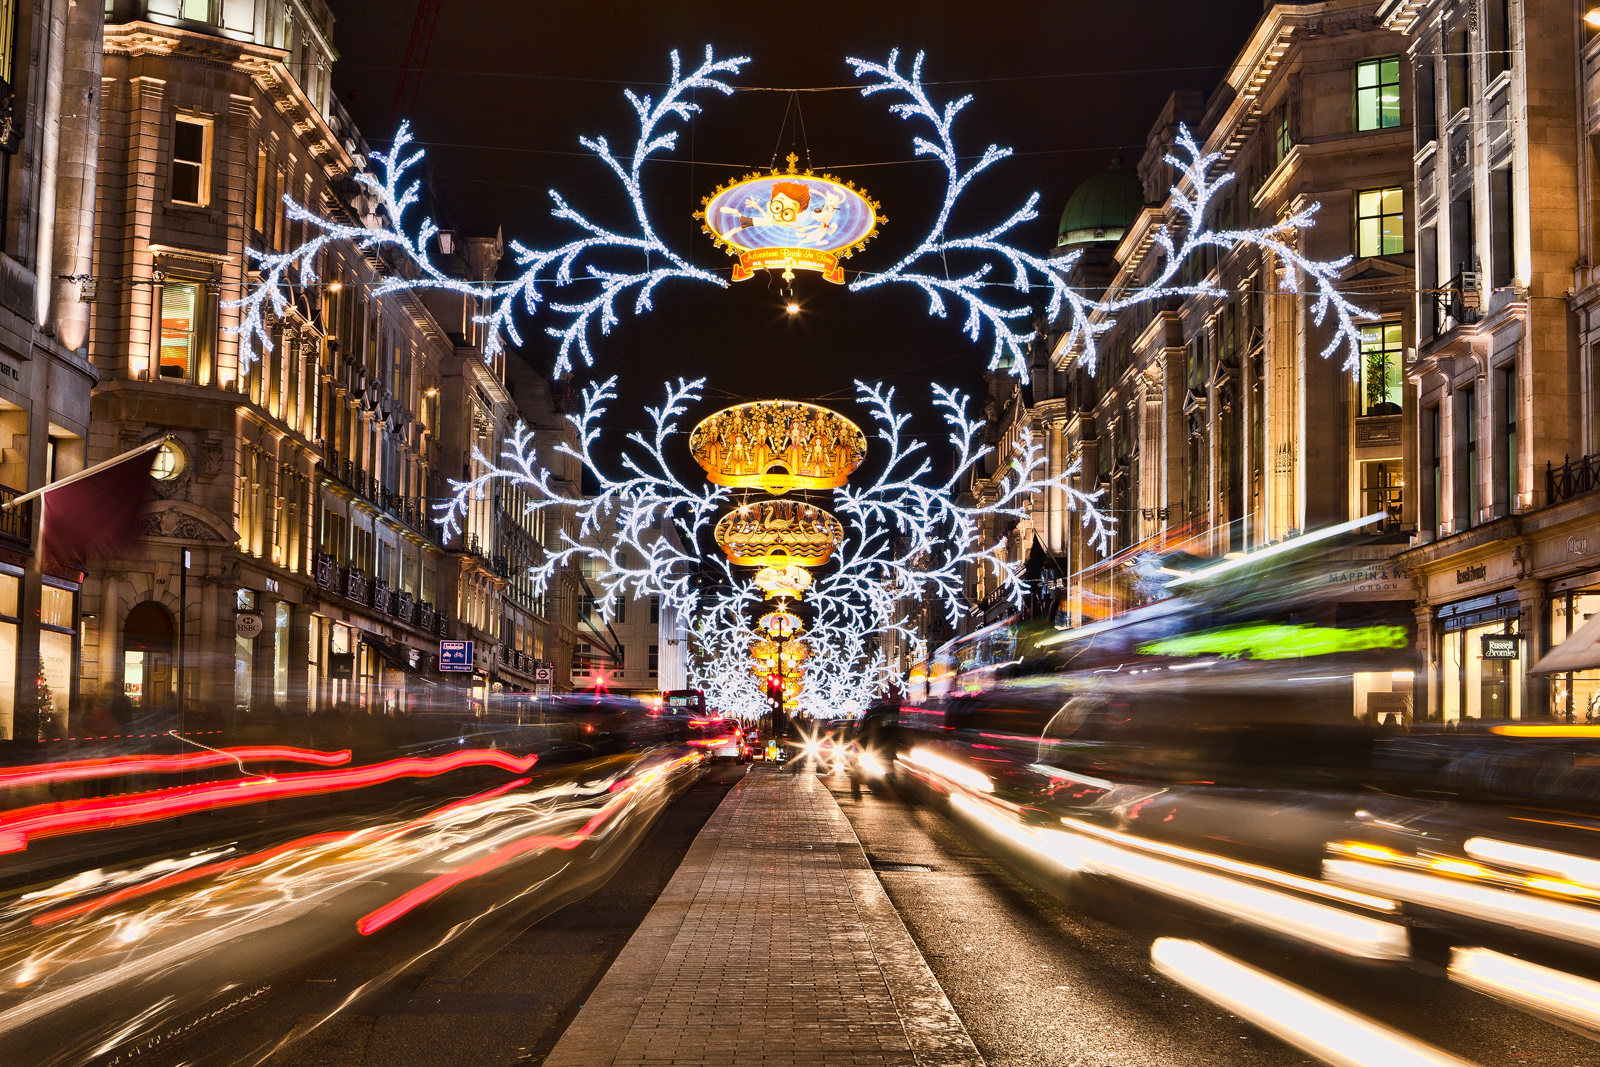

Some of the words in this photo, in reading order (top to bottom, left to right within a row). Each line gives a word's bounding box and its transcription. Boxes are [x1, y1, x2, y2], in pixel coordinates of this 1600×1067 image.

[744, 250, 778, 263] Adventure
[780, 248, 802, 258] Back
[803, 249, 814, 259] In
[816, 251, 835, 265] Time
[1329, 571, 1377, 582] MAPPIN
[1381, 571, 1389, 579] &
[1353, 583, 1398, 591] LONDON
[1489, 641, 1513, 649] Russell
[1377, 696, 1402, 704] Cartier
